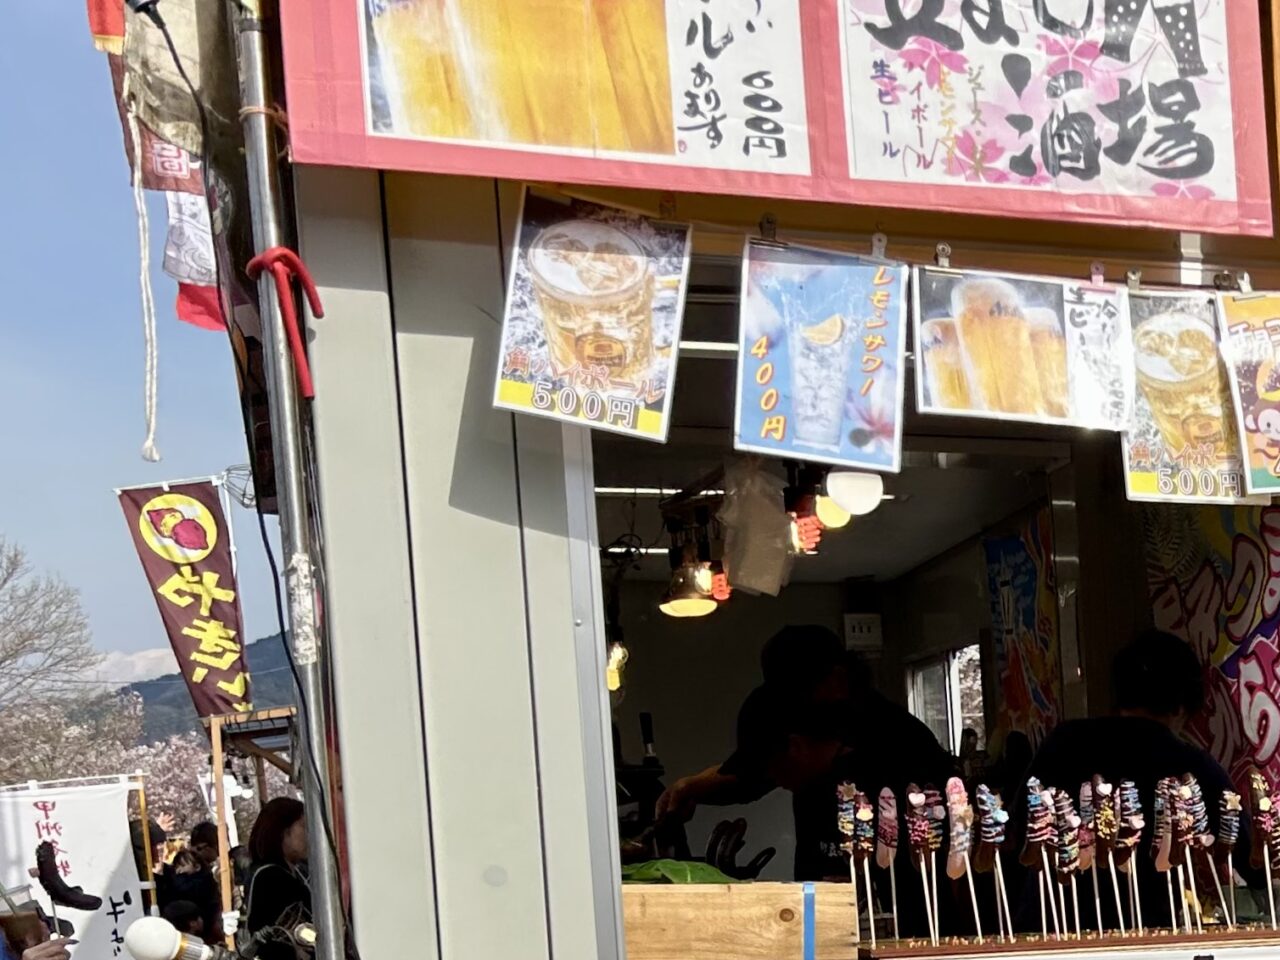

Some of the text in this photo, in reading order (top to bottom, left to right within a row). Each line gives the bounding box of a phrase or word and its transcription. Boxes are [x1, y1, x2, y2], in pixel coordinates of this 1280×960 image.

[869, 58, 901, 158] 生ビール
[1000, 52, 1215, 182] 酒場
[503, 347, 665, 404] 角ハイボール
[861, 265, 895, 397] レモンサワー
[532, 381, 637, 428] 500円
[751, 336, 787, 442] 400円
[1158, 468, 1240, 497] 500円
